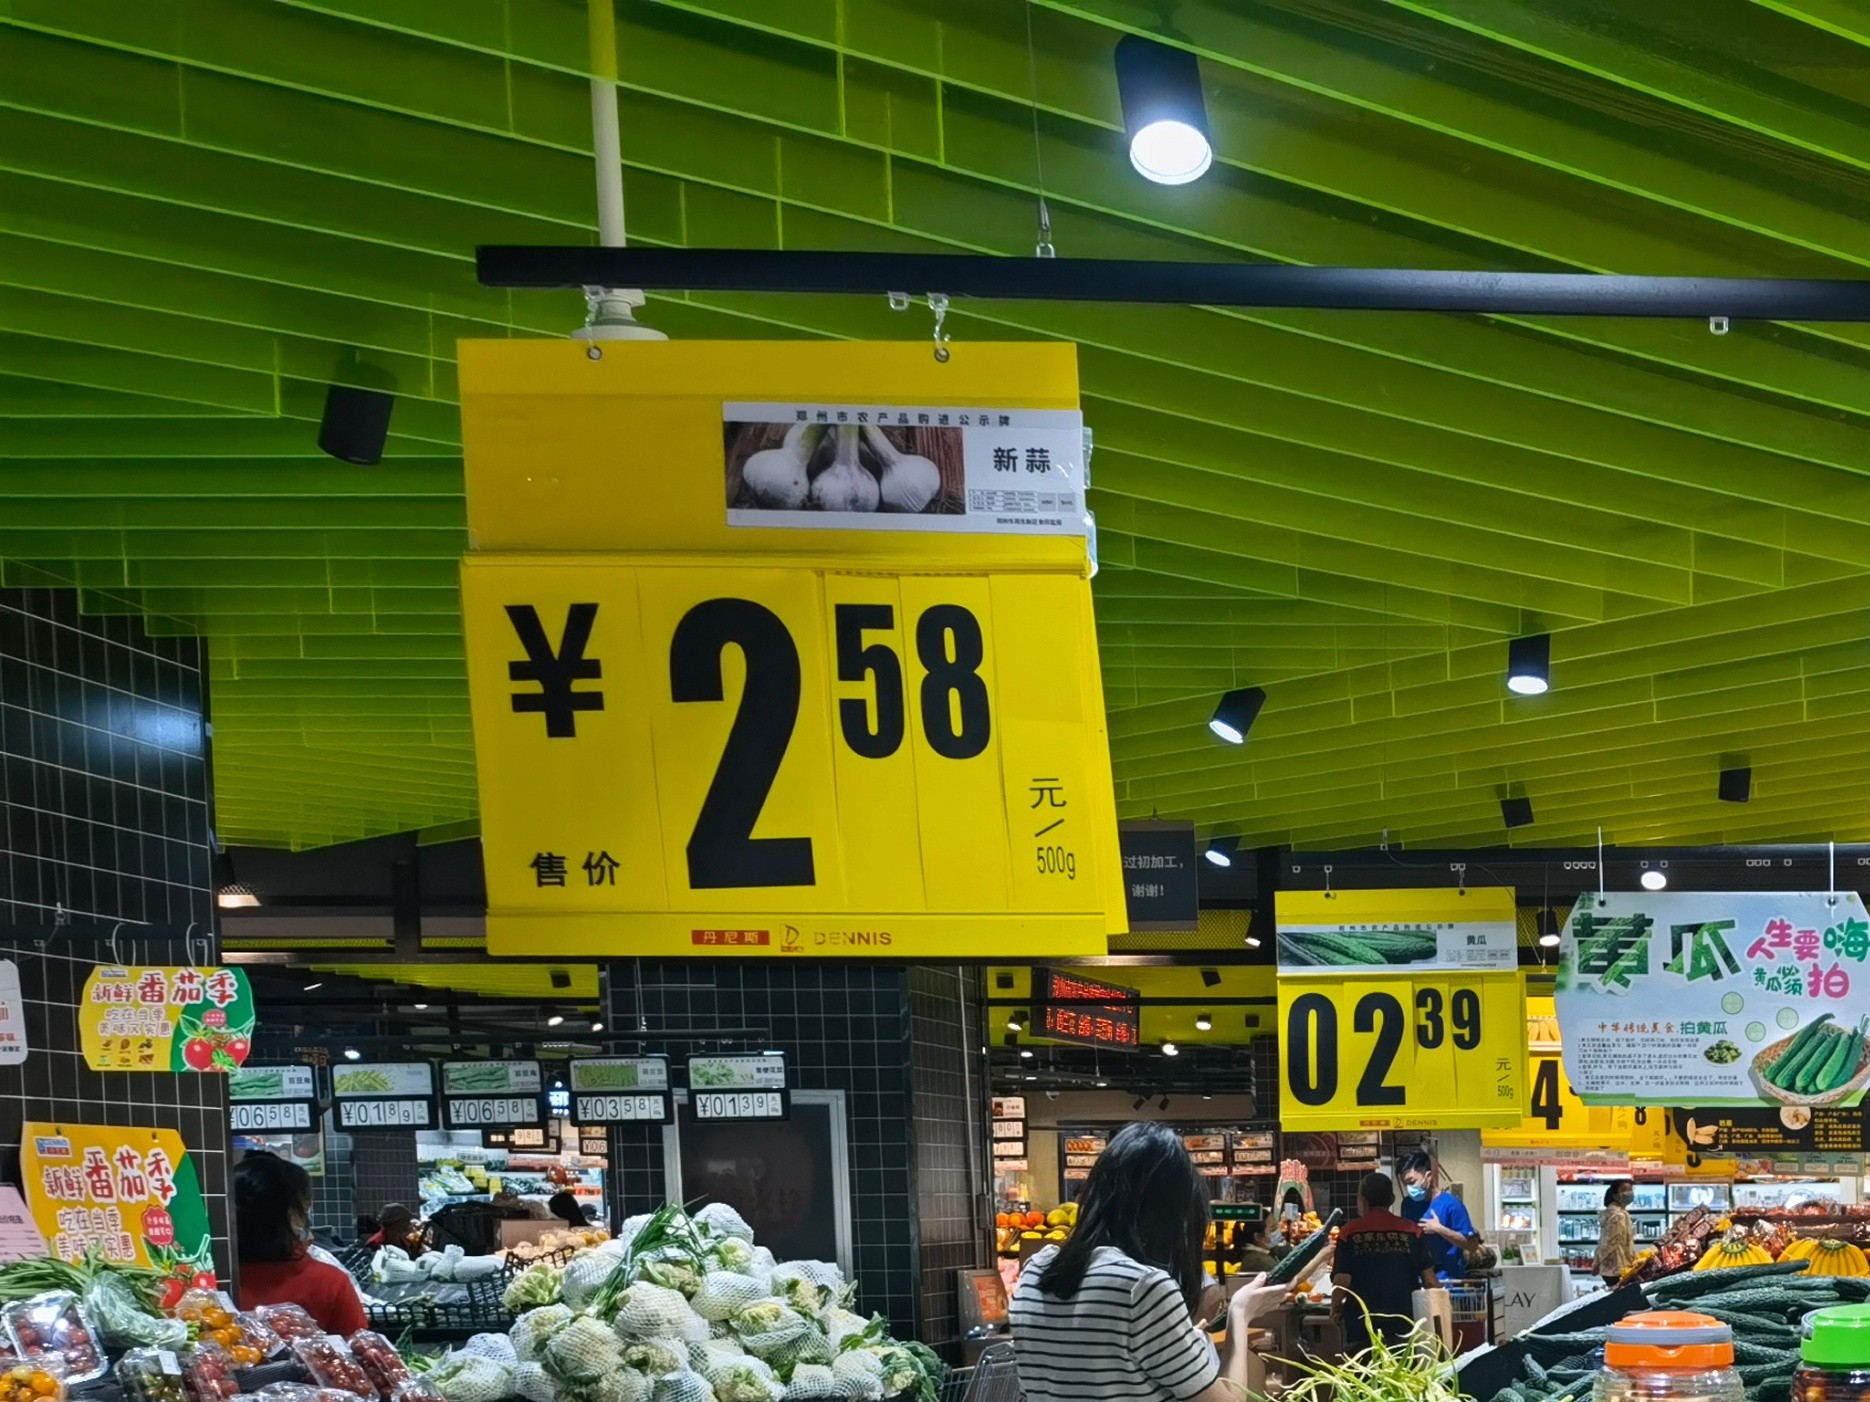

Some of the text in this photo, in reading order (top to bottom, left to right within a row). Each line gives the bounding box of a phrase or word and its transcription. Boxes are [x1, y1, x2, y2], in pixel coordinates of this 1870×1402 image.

[990, 445, 1053, 474] 新蒜
[1030, 778, 1067, 809] 元
[530, 851, 620, 887] 售价
[1037, 846, 1075, 880] 500g
[703, 932, 759, 944] 丹尼斯
[1465, 934, 1487, 946] 黄瓜
[1572, 913, 1741, 990] 黄瓜
[93, 972, 235, 1005] 新鲜番茄季
[1497, 1058, 1511, 1071] 元
[45, 1150, 174, 1200] 新鲜番茄季
[1504, 1292, 1536, 1308] AY
